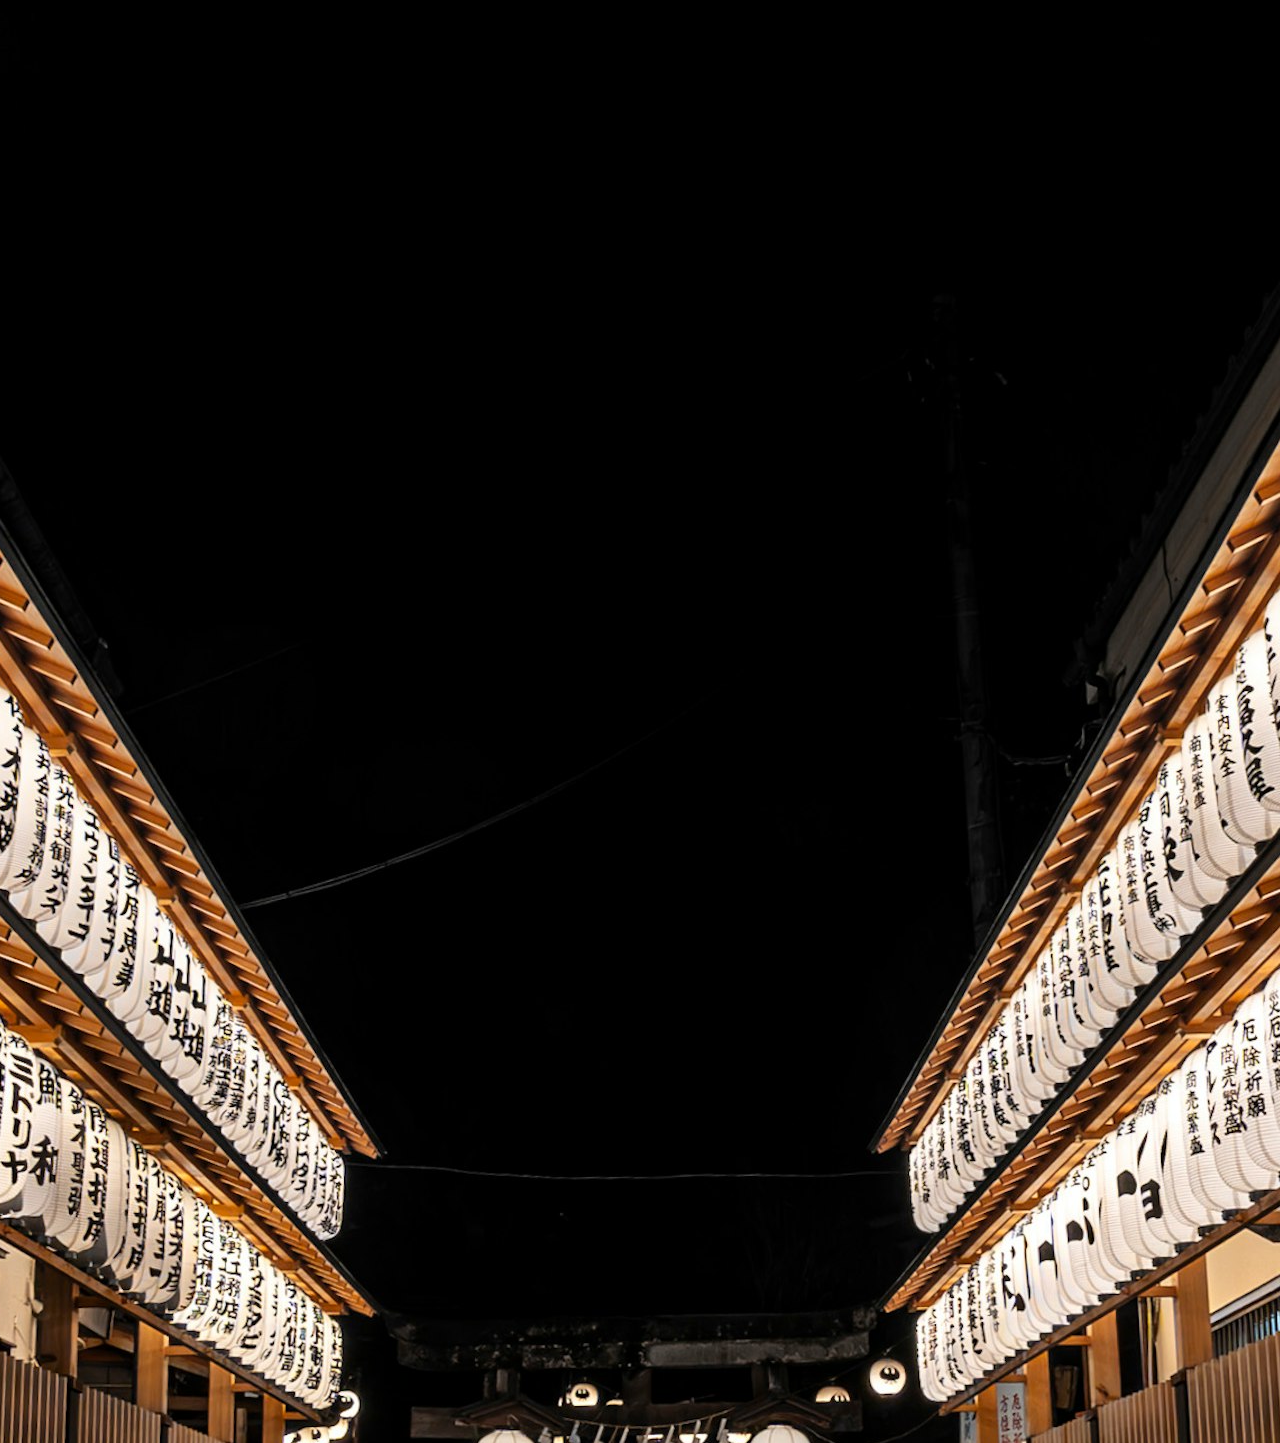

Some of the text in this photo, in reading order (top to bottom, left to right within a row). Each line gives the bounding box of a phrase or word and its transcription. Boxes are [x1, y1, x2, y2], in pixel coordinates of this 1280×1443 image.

[1188, 734, 1207, 809] 商売繁盛
[1215, 693, 1237, 778] 家内安全
[1240, 1018, 1268, 1119] 厄除祈願
